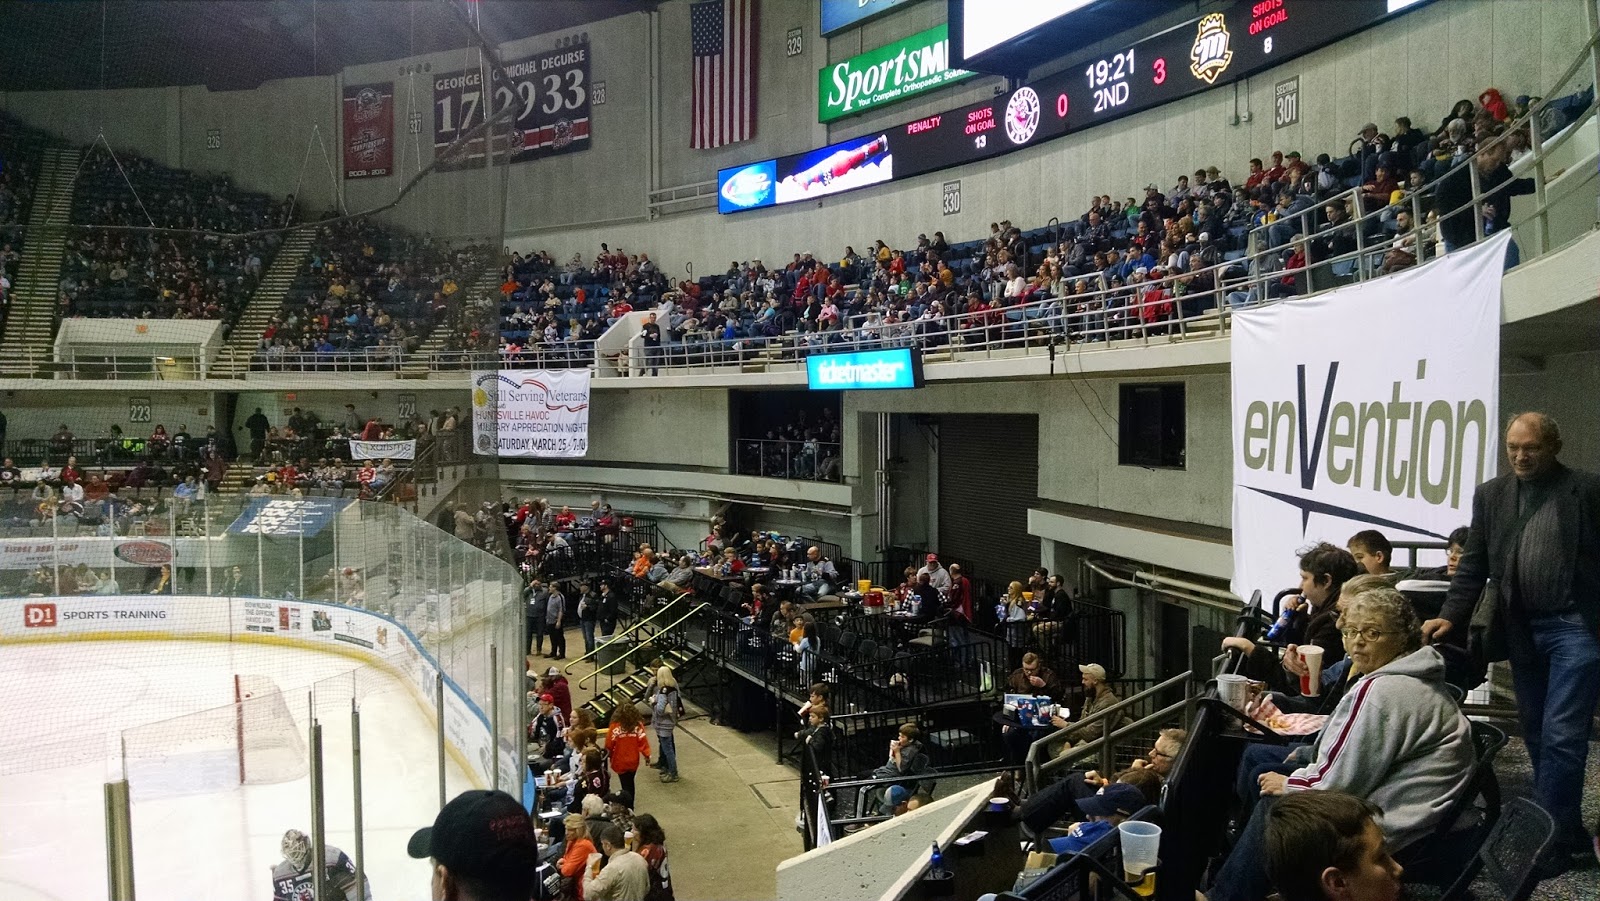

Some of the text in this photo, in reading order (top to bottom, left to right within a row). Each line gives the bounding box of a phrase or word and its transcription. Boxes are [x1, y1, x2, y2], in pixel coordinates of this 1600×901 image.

[1253, 0, 1283, 17] SHOTS
[1249, 9, 1288, 35] ON GOAL
[787, 36, 802, 56] 329
[1264, 37, 1273, 53] 8
[541, 49, 585, 71] DEGURSE
[492, 60, 537, 82] CMICHAEL
[1086, 49, 1135, 89] 19:21
[1153, 58, 1166, 85] 3
[435, 74, 481, 91] GEORGE
[858, 97, 871, 107] Your
[872, 88, 901, 102] Complete
[902, 75, 942, 93] Orthopaedic
[1276, 80, 1298, 96] SECTION
[542, 69, 586, 114] 33
[592, 88, 605, 105] 328
[1093, 82, 1130, 113] 2ND
[495, 81, 536, 123] 29
[1057, 93, 1069, 117] 0
[1277, 92, 1297, 126] 301
[437, 91, 480, 133] 17
[967, 107, 993, 123] SHOTS
[907, 116, 942, 135] PENALTY
[965, 118, 997, 135] ON GOAL
[974, 135, 987, 149] 13
[944, 183, 960, 193] SECTION
[943, 192, 960, 214] 330
[488, 389, 507, 402] Still
[508, 389, 544, 405] Serving
[546, 389, 588, 402] Veterans
[130, 405, 151, 422] 223
[399, 402, 415, 419] 224
[475, 410, 550, 421] HUNTSVILLE HAVOC
[476, 422, 587, 433] MILITARY APPRECIATION NIGHT
[1243, 359, 1487, 510] enVention
[532, 438, 556, 451] MARCH
[558, 438, 567, 451] 25
[28, 607, 54, 624] D1
[63, 610, 167, 620] SPORTS TRAINING
[279, 879, 294, 895] 35
